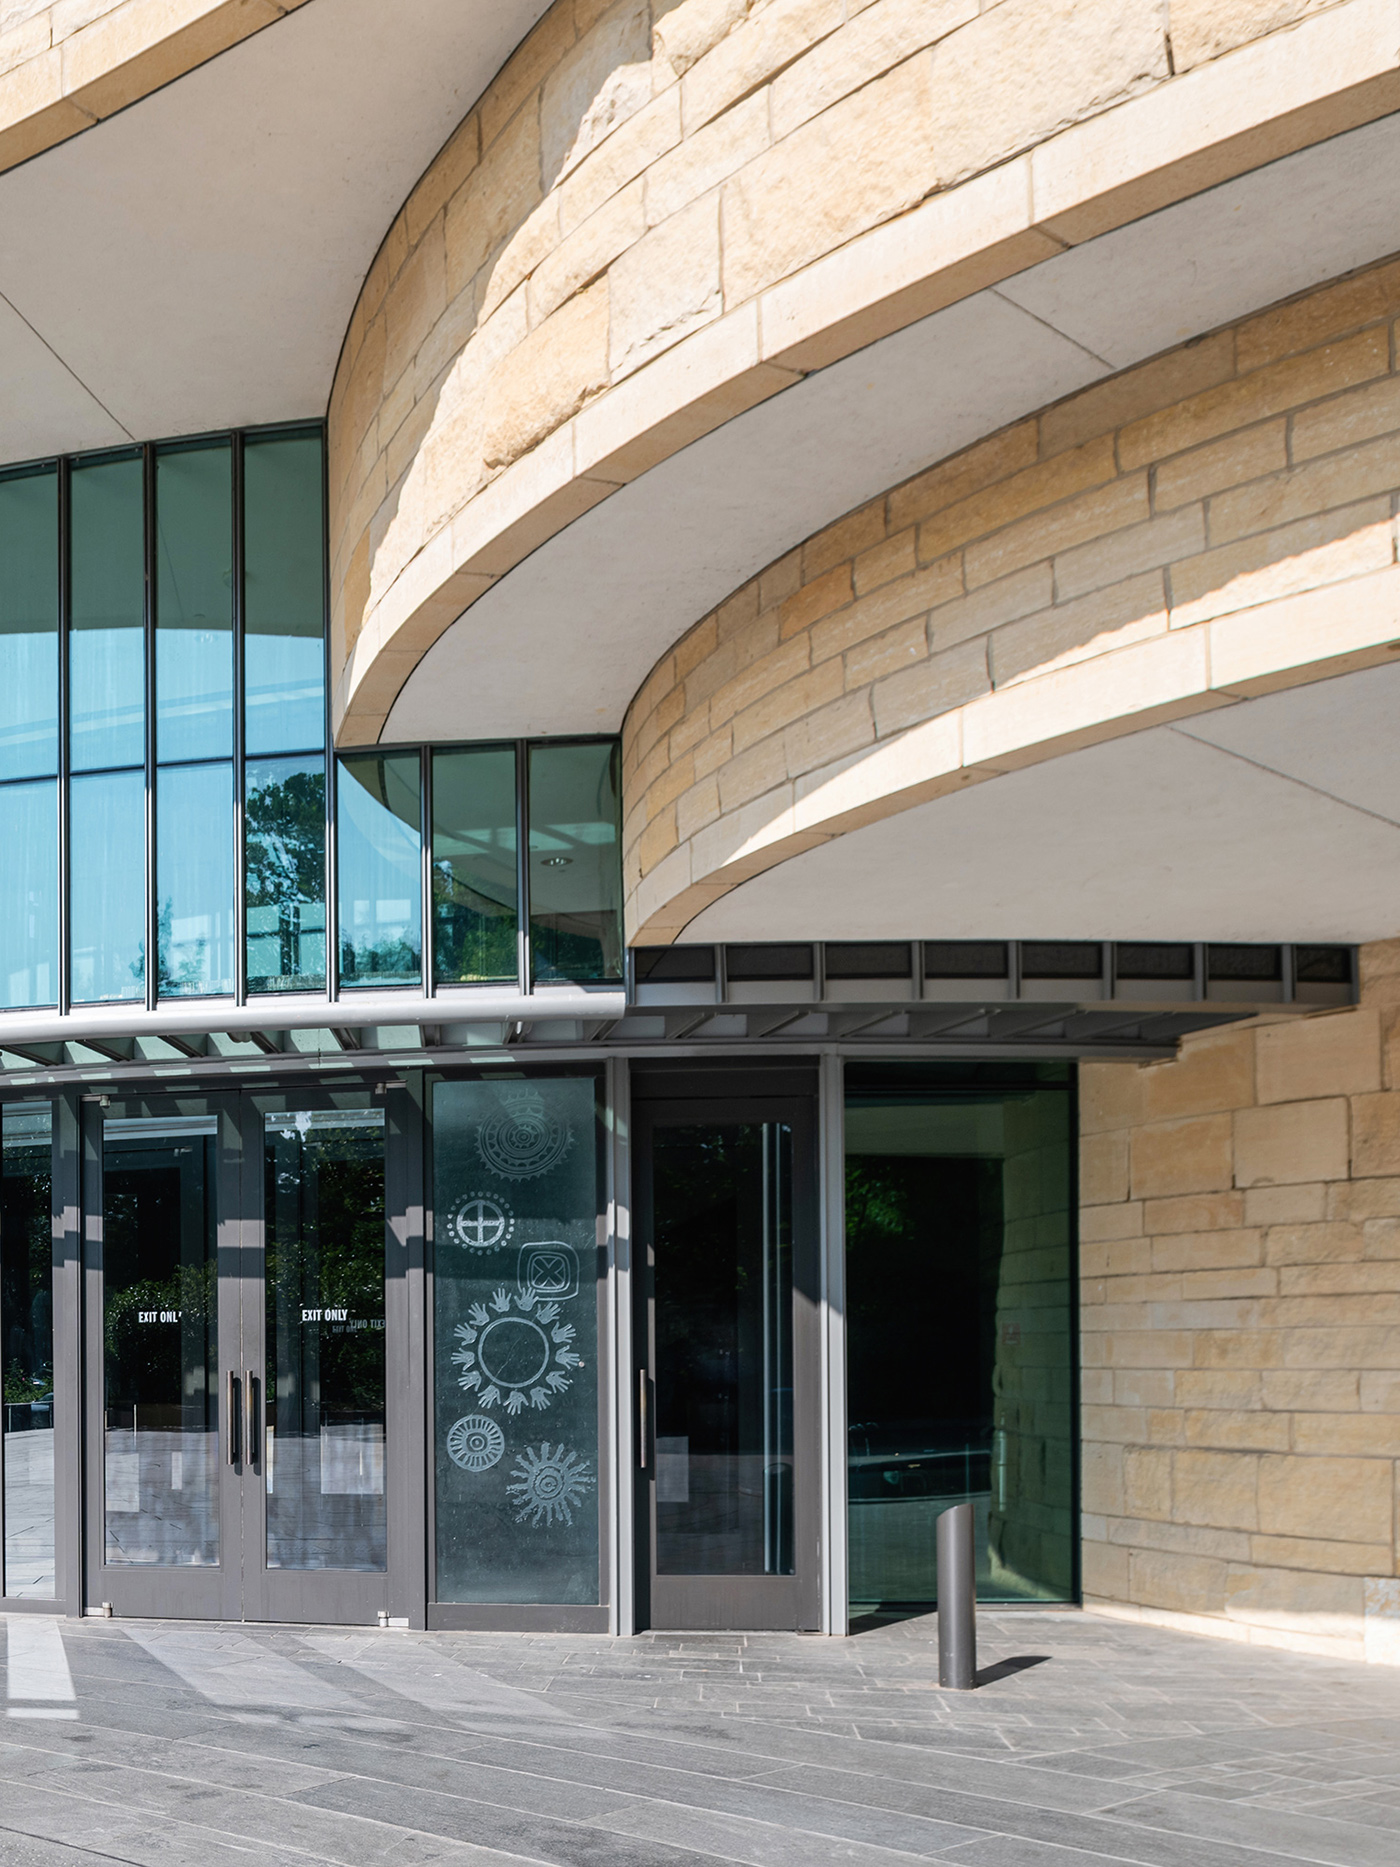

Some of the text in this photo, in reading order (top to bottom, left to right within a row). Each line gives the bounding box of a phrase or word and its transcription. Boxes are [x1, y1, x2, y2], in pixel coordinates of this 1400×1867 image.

[138, 1311, 158, 1323] EXIT
[302, 1309, 348, 1322] EXIT ONLY
